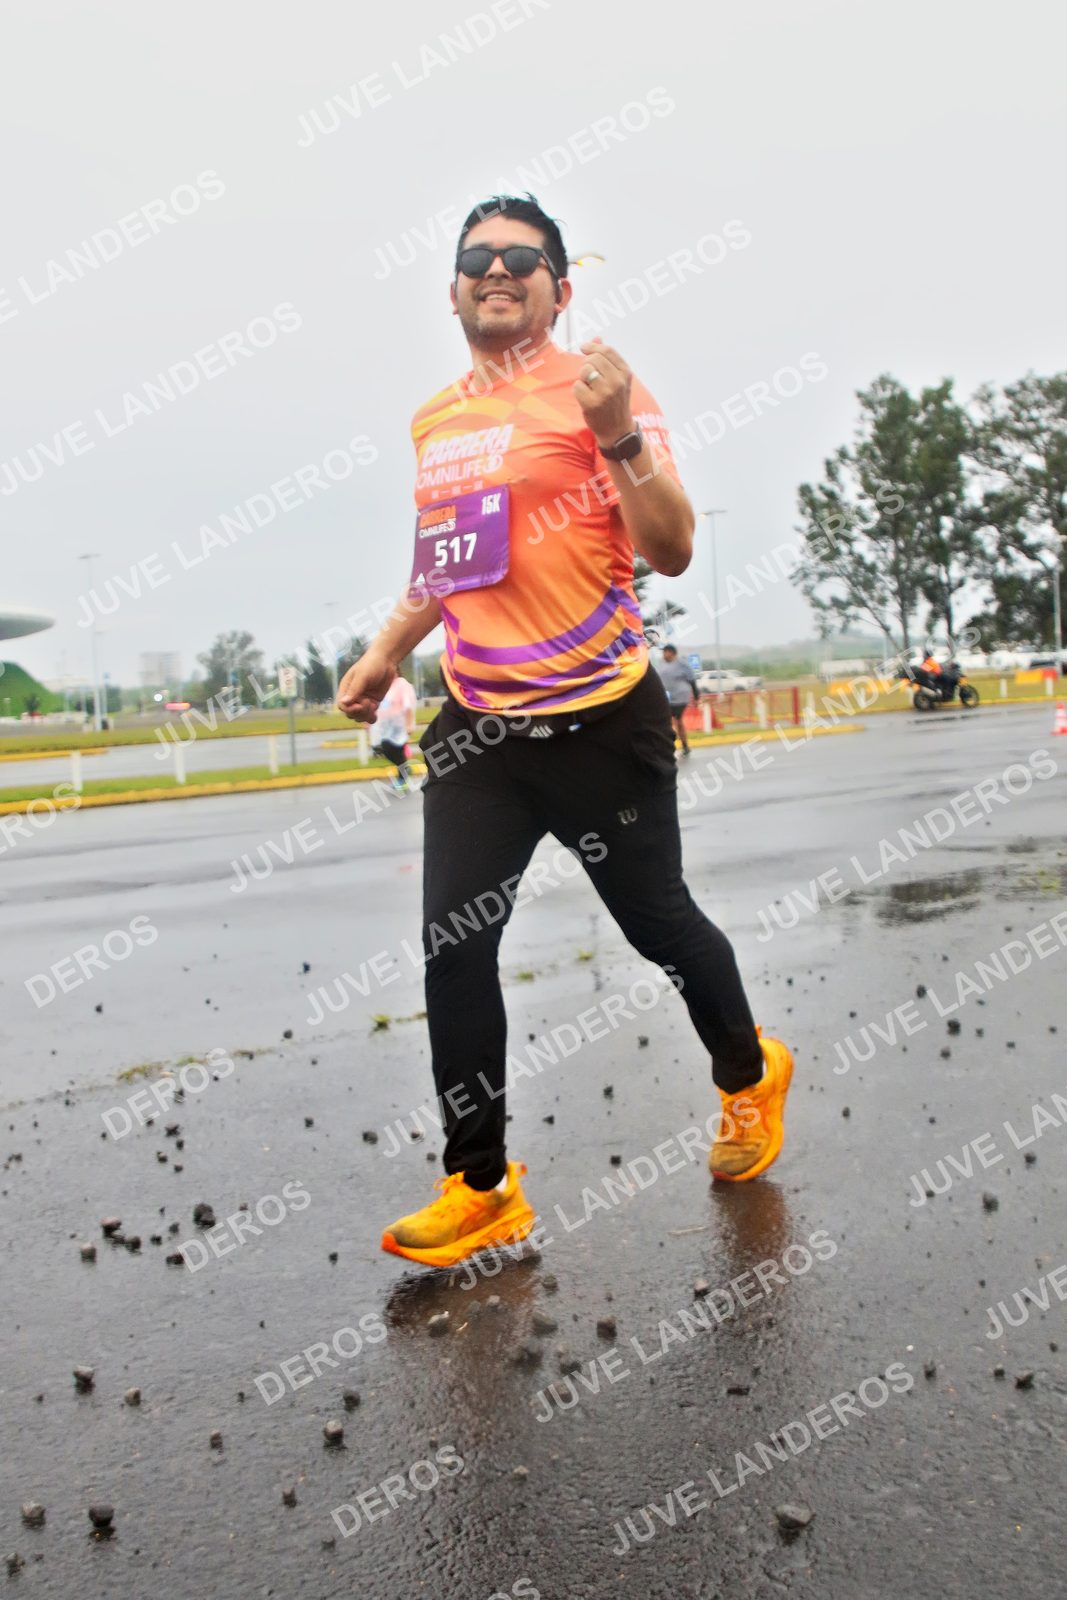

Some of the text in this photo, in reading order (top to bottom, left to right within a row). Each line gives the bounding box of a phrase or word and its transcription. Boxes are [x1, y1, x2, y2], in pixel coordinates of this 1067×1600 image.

[421, 423, 514, 469] CARRERA
[415, 458, 484, 490] OMNILIFE
[481, 493, 501, 516] 15K
[434, 532, 477, 567] 517
